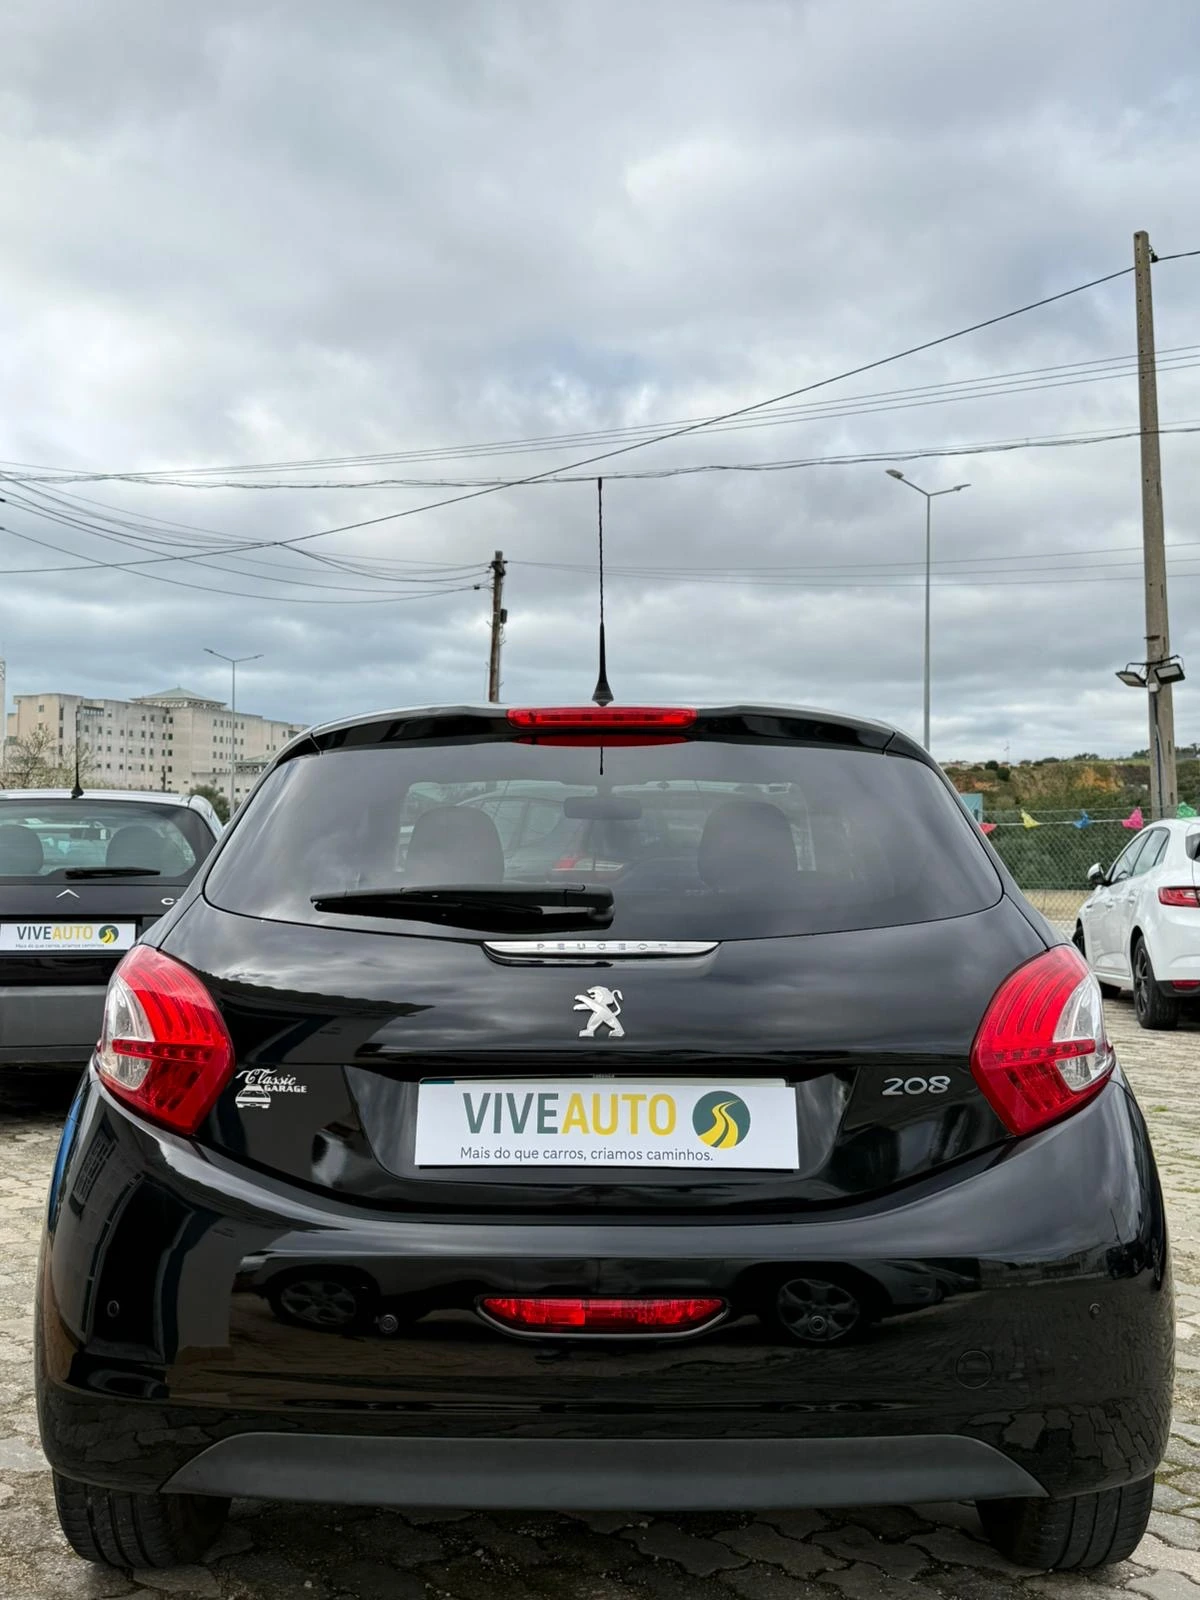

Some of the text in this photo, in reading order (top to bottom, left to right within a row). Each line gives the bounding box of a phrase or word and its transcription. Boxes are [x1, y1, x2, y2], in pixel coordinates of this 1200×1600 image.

[160, 897, 180, 905] C
[16, 925, 94, 940] VIVEAUTO
[536, 942, 669, 951] PEUGEOT
[234, 1068, 297, 1086] Classic
[263, 1084, 308, 1093] GARAGE
[881, 1075, 951, 1096] 208
[462, 1092, 677, 1136] VIVEAUTO
[460, 1146, 714, 1162] Mais do que carros, criamos caminhos.
